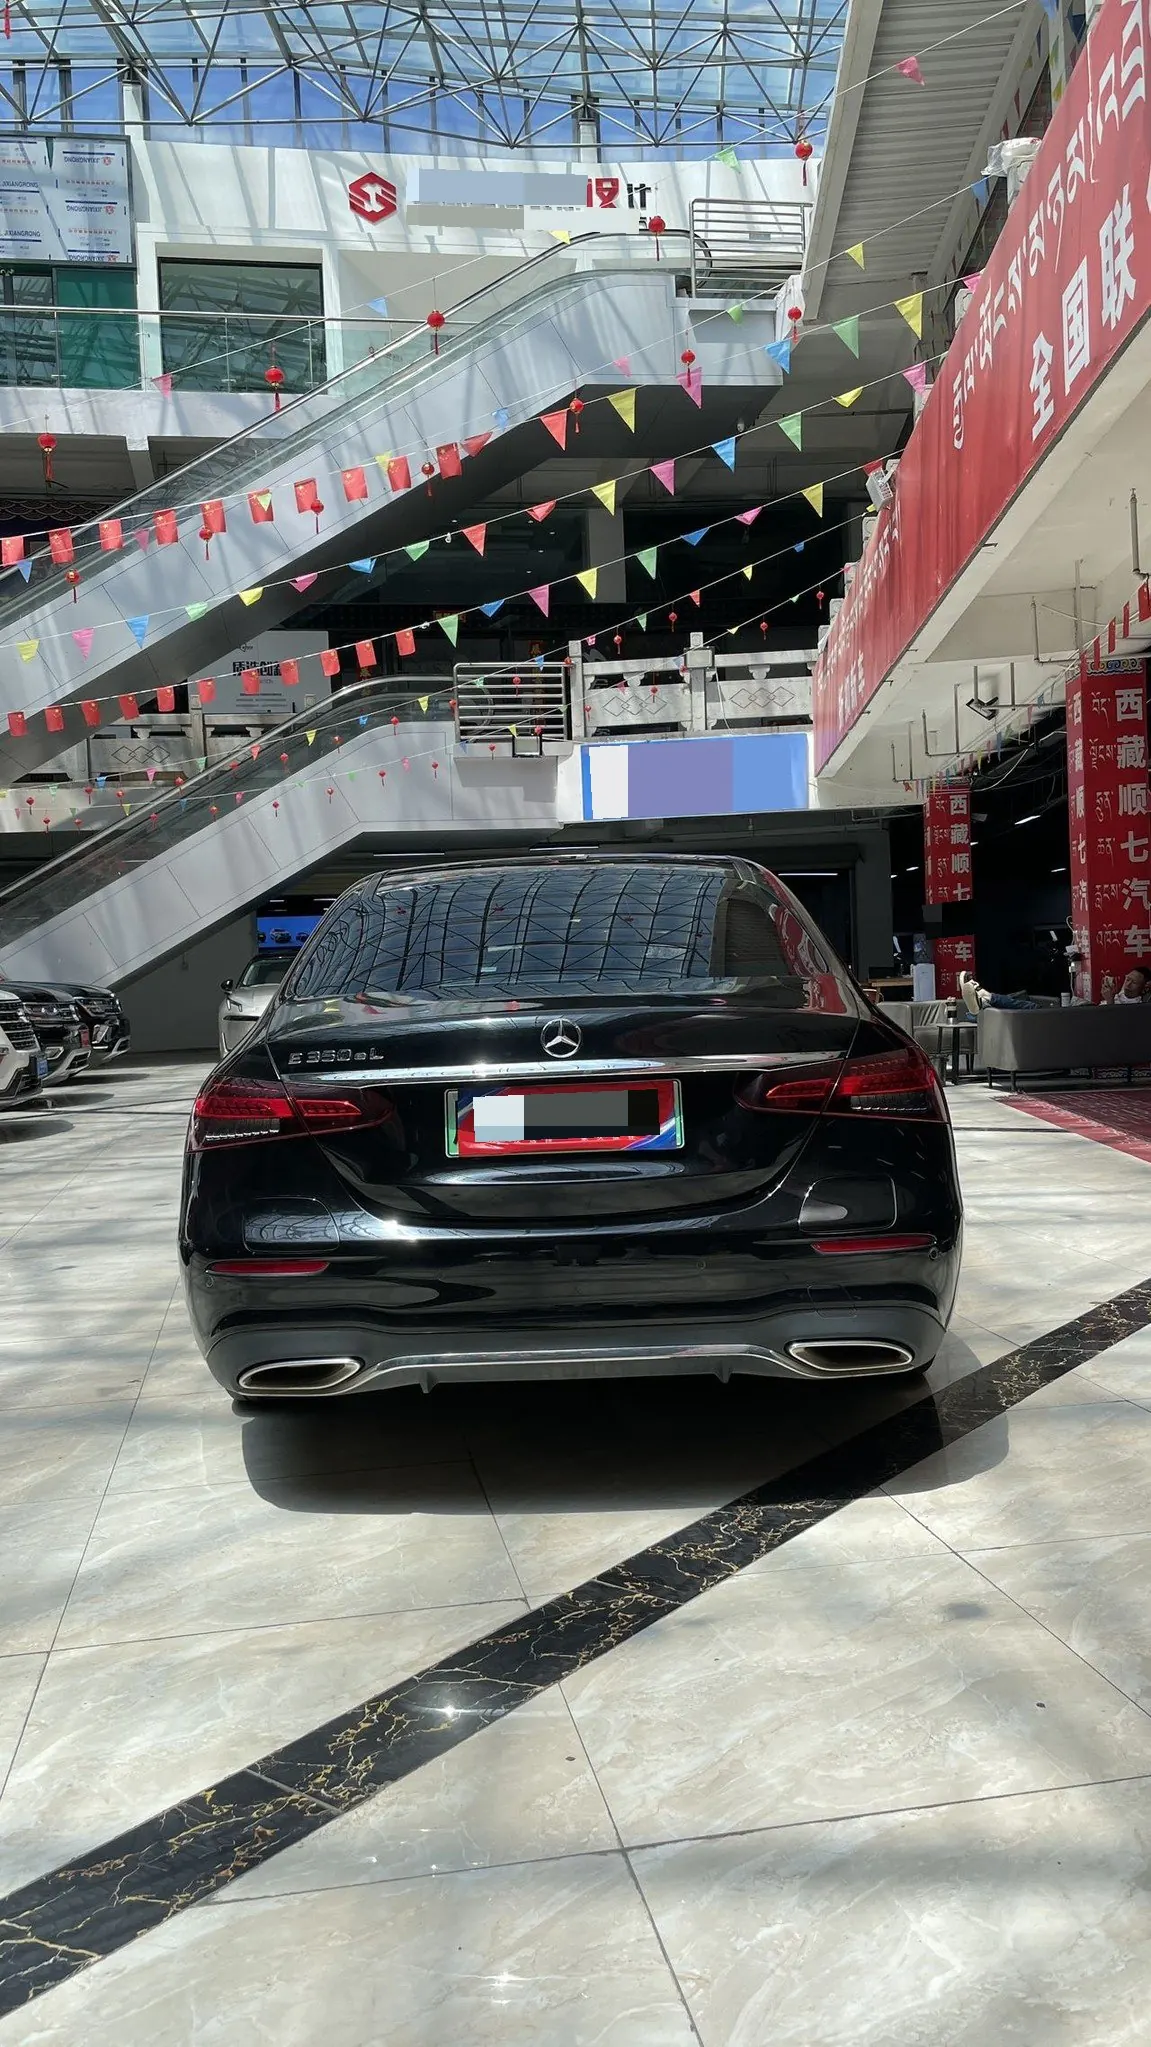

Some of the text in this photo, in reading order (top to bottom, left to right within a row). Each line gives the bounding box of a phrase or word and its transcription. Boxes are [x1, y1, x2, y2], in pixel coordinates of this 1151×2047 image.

[1029, 172, 1151, 442] 全国联
[1114, 688, 1151, 958] 西藏顺七汽车
